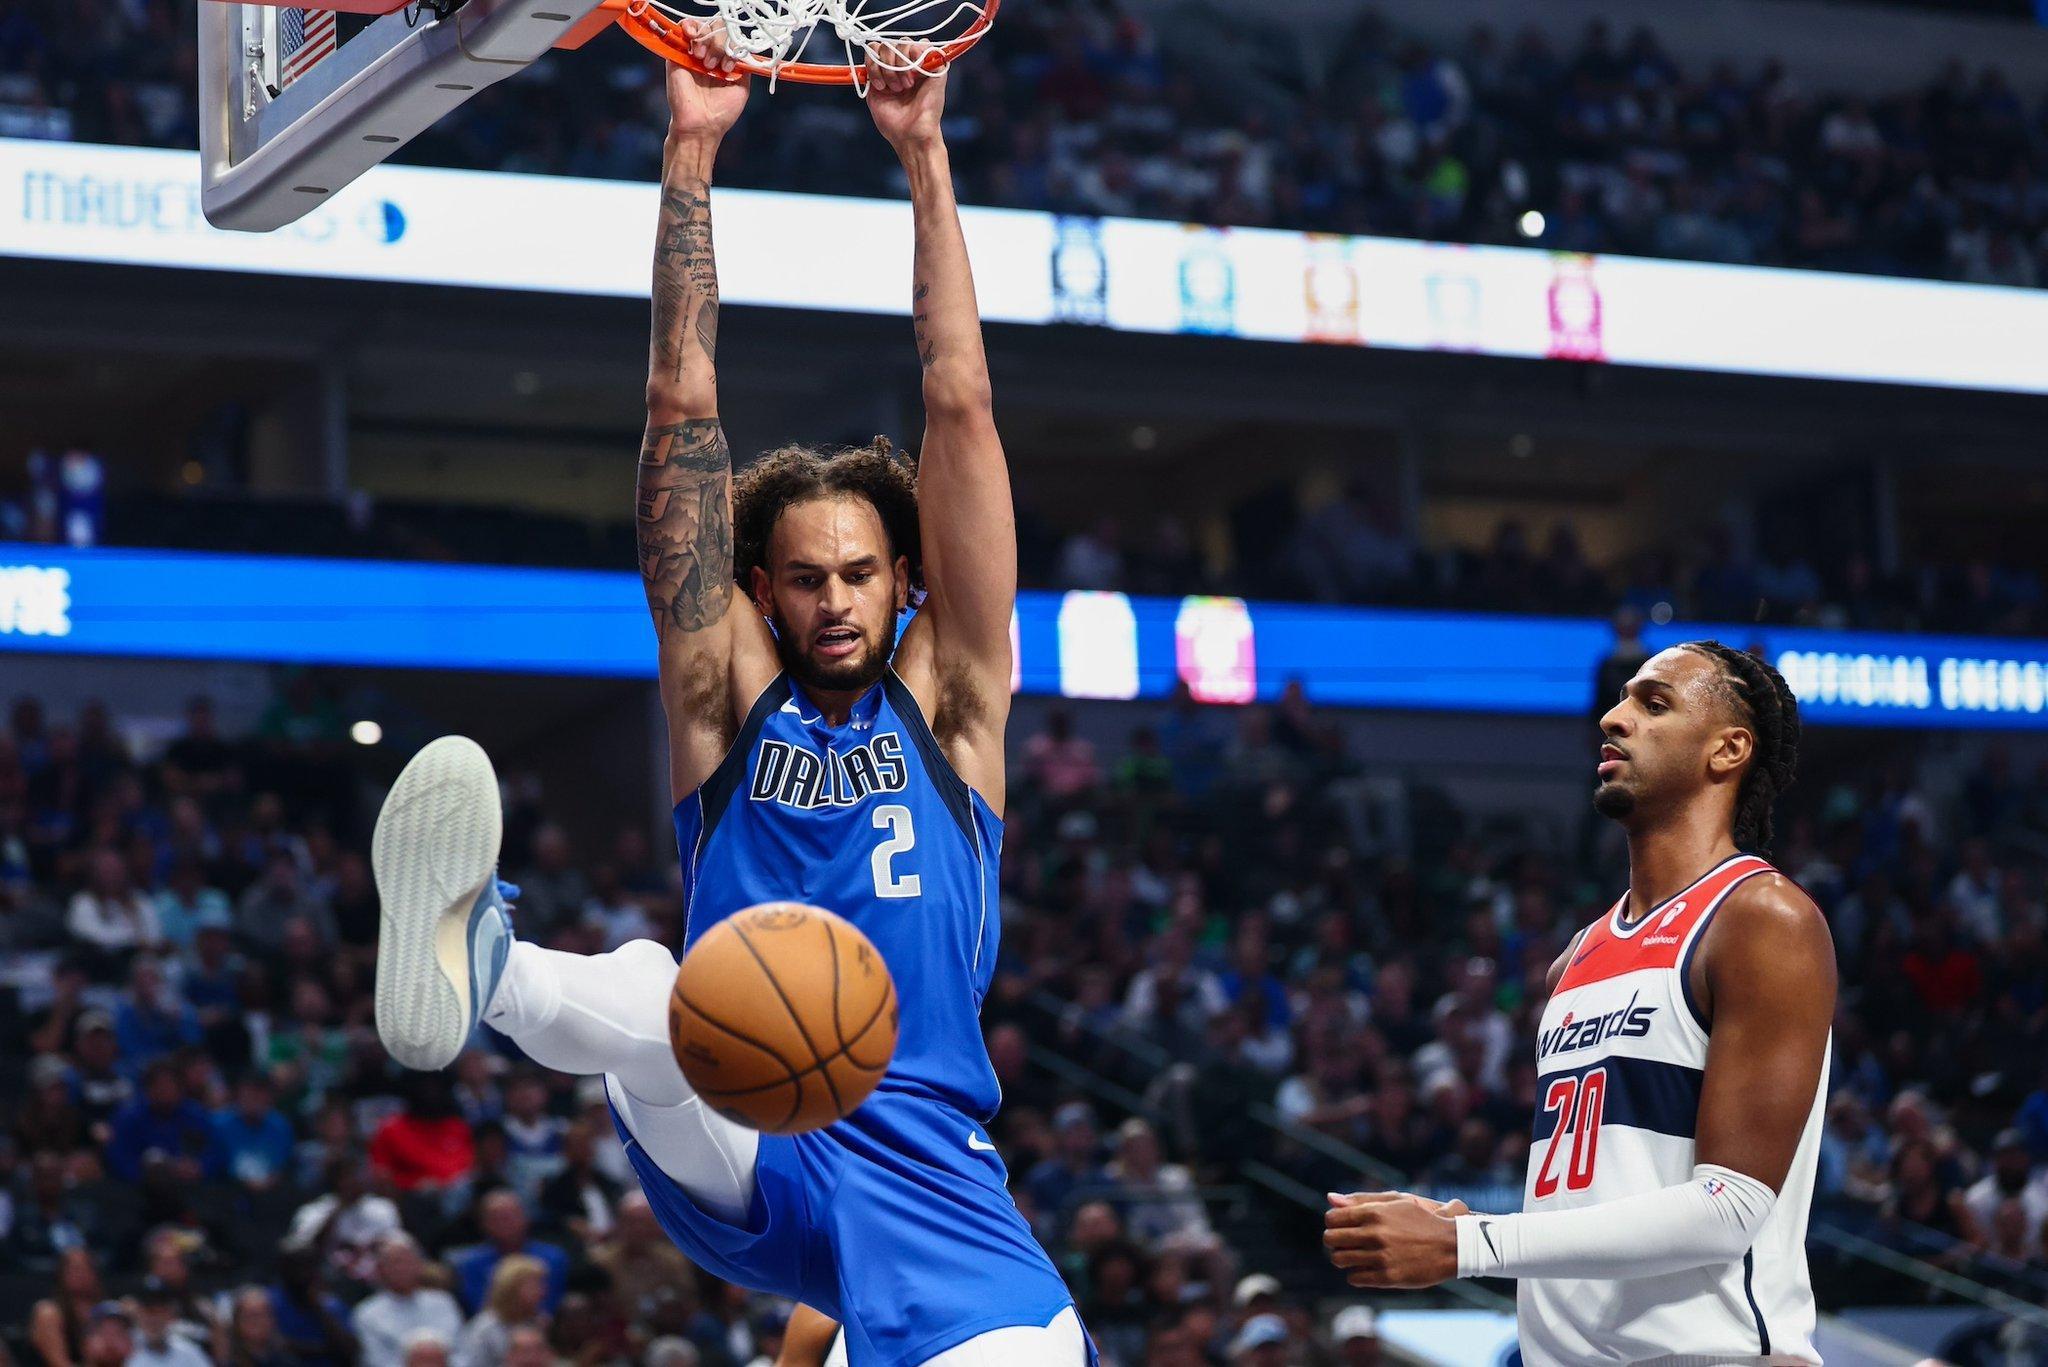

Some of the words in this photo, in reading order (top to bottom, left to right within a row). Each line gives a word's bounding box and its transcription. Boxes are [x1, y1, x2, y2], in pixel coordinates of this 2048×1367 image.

[750, 732, 908, 809] DALLAS
[871, 804, 922, 899] 2
[1641, 934, 1680, 948] Robinhood
[1534, 1067, 1607, 1200] 20
